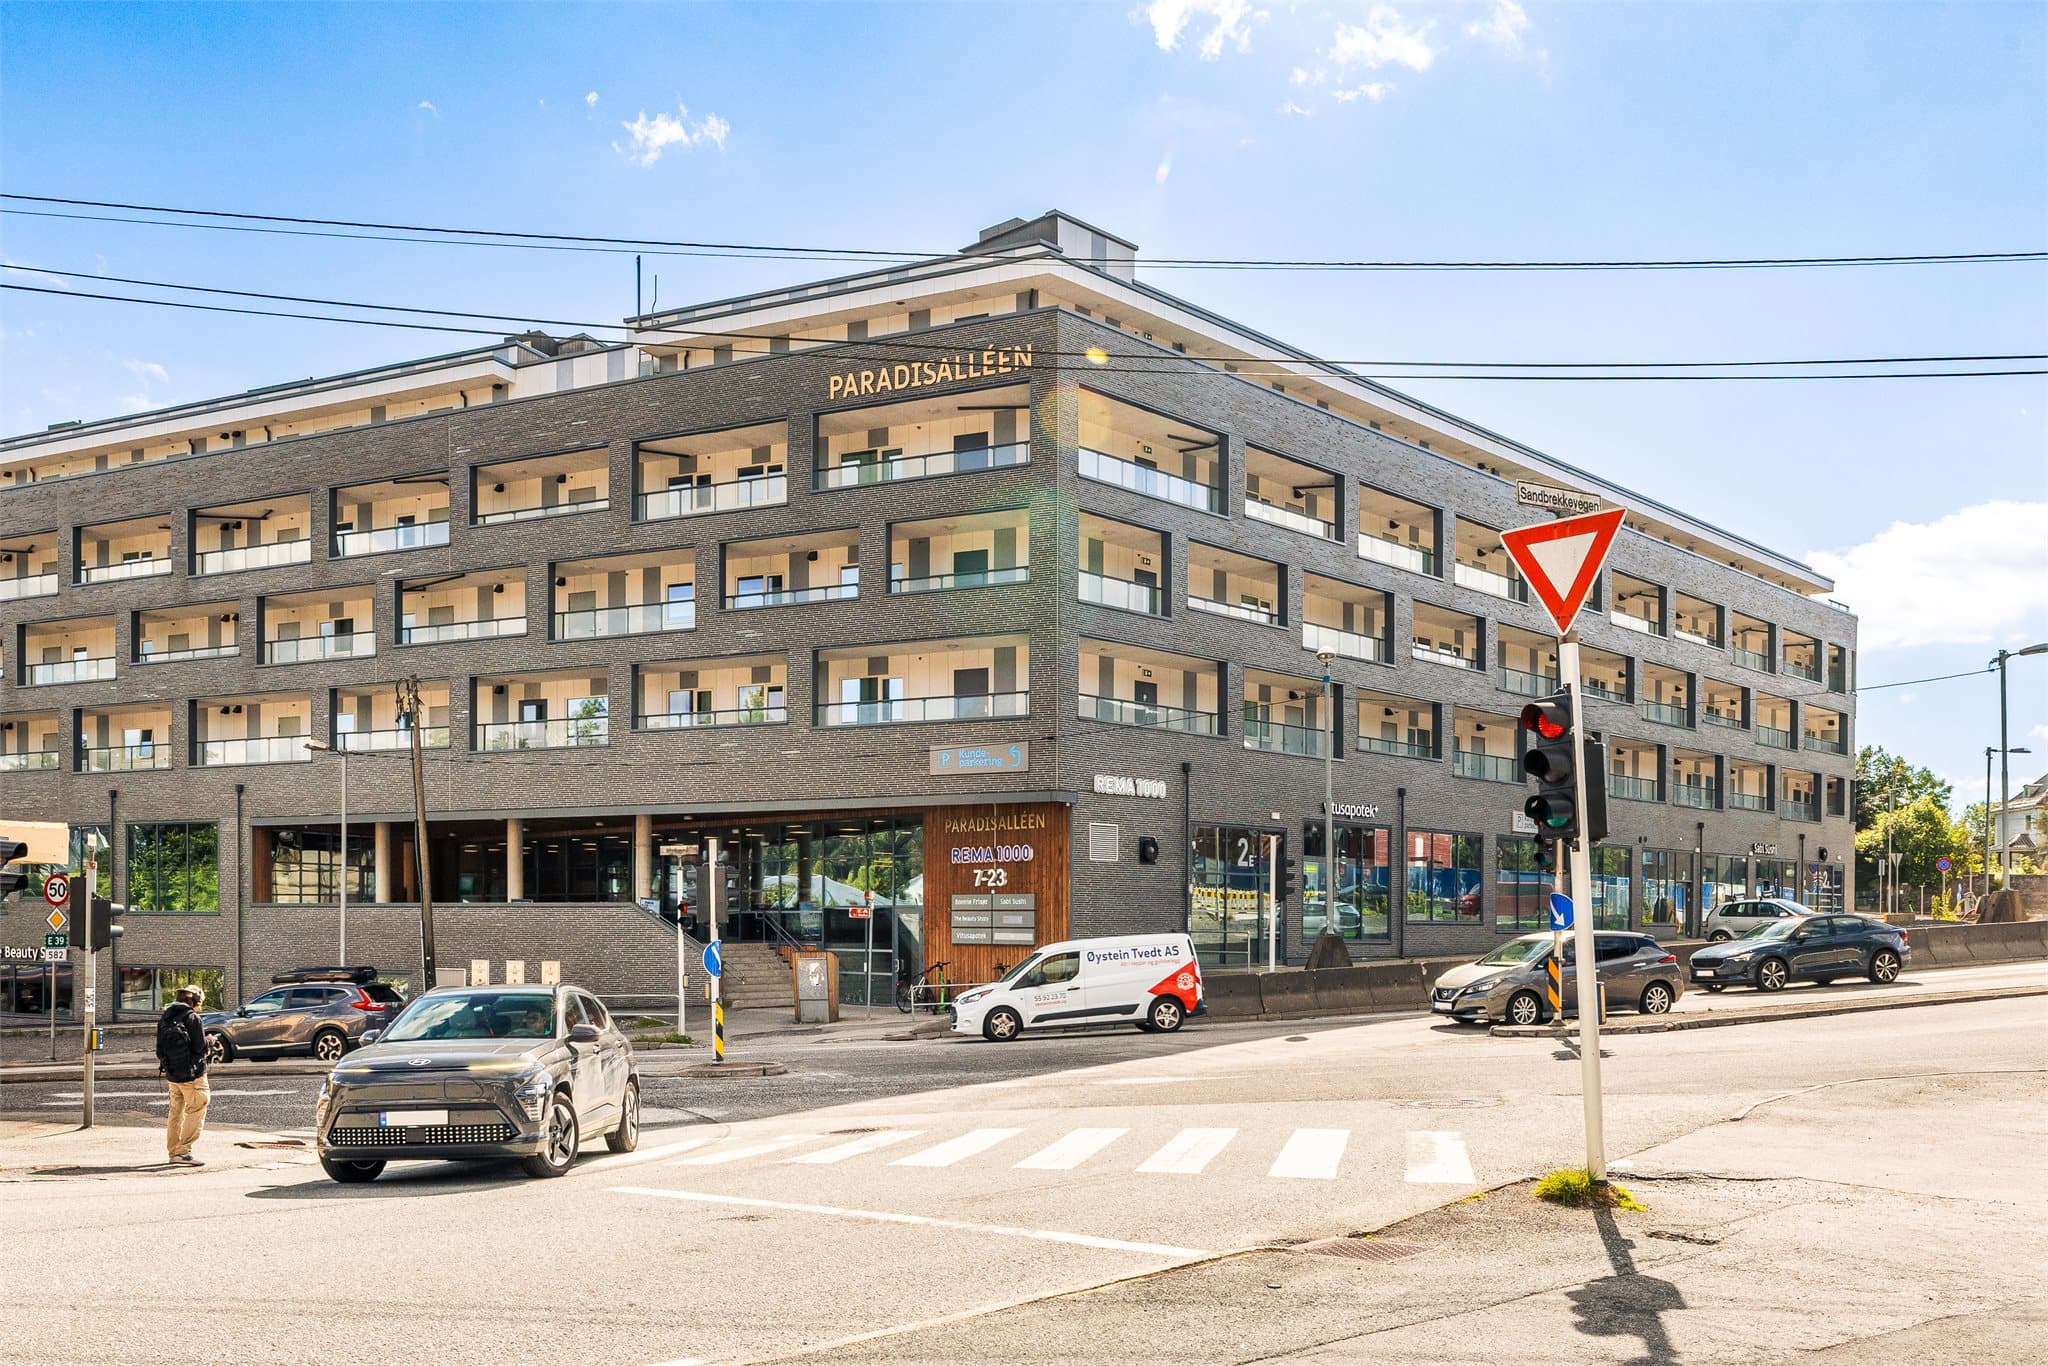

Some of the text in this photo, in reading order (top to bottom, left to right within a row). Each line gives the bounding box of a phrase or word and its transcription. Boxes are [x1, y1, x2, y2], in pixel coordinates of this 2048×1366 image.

[829, 343, 1033, 400] PARADISALLÉEN
[1520, 486, 1600, 513] Sandbrekkevegen
[958, 757, 1003, 769] parkering
[1093, 774, 1167, 799] REMA 1000
[945, 811, 1045, 833] PARADISALLÉEN
[951, 844, 1033, 864] REMA 1000
[973, 868, 1008, 887] 7-23
[49, 882, 66, 897] 50
[48, 936, 65, 945] E 39
[4, 945, 38, 961] Beauty
[48, 950, 64, 959] 582
[1086, 949, 1130, 965] Øystein
[1130, 946, 1162, 959] Tvedt
[1164, 945, 1180, 957] AS
